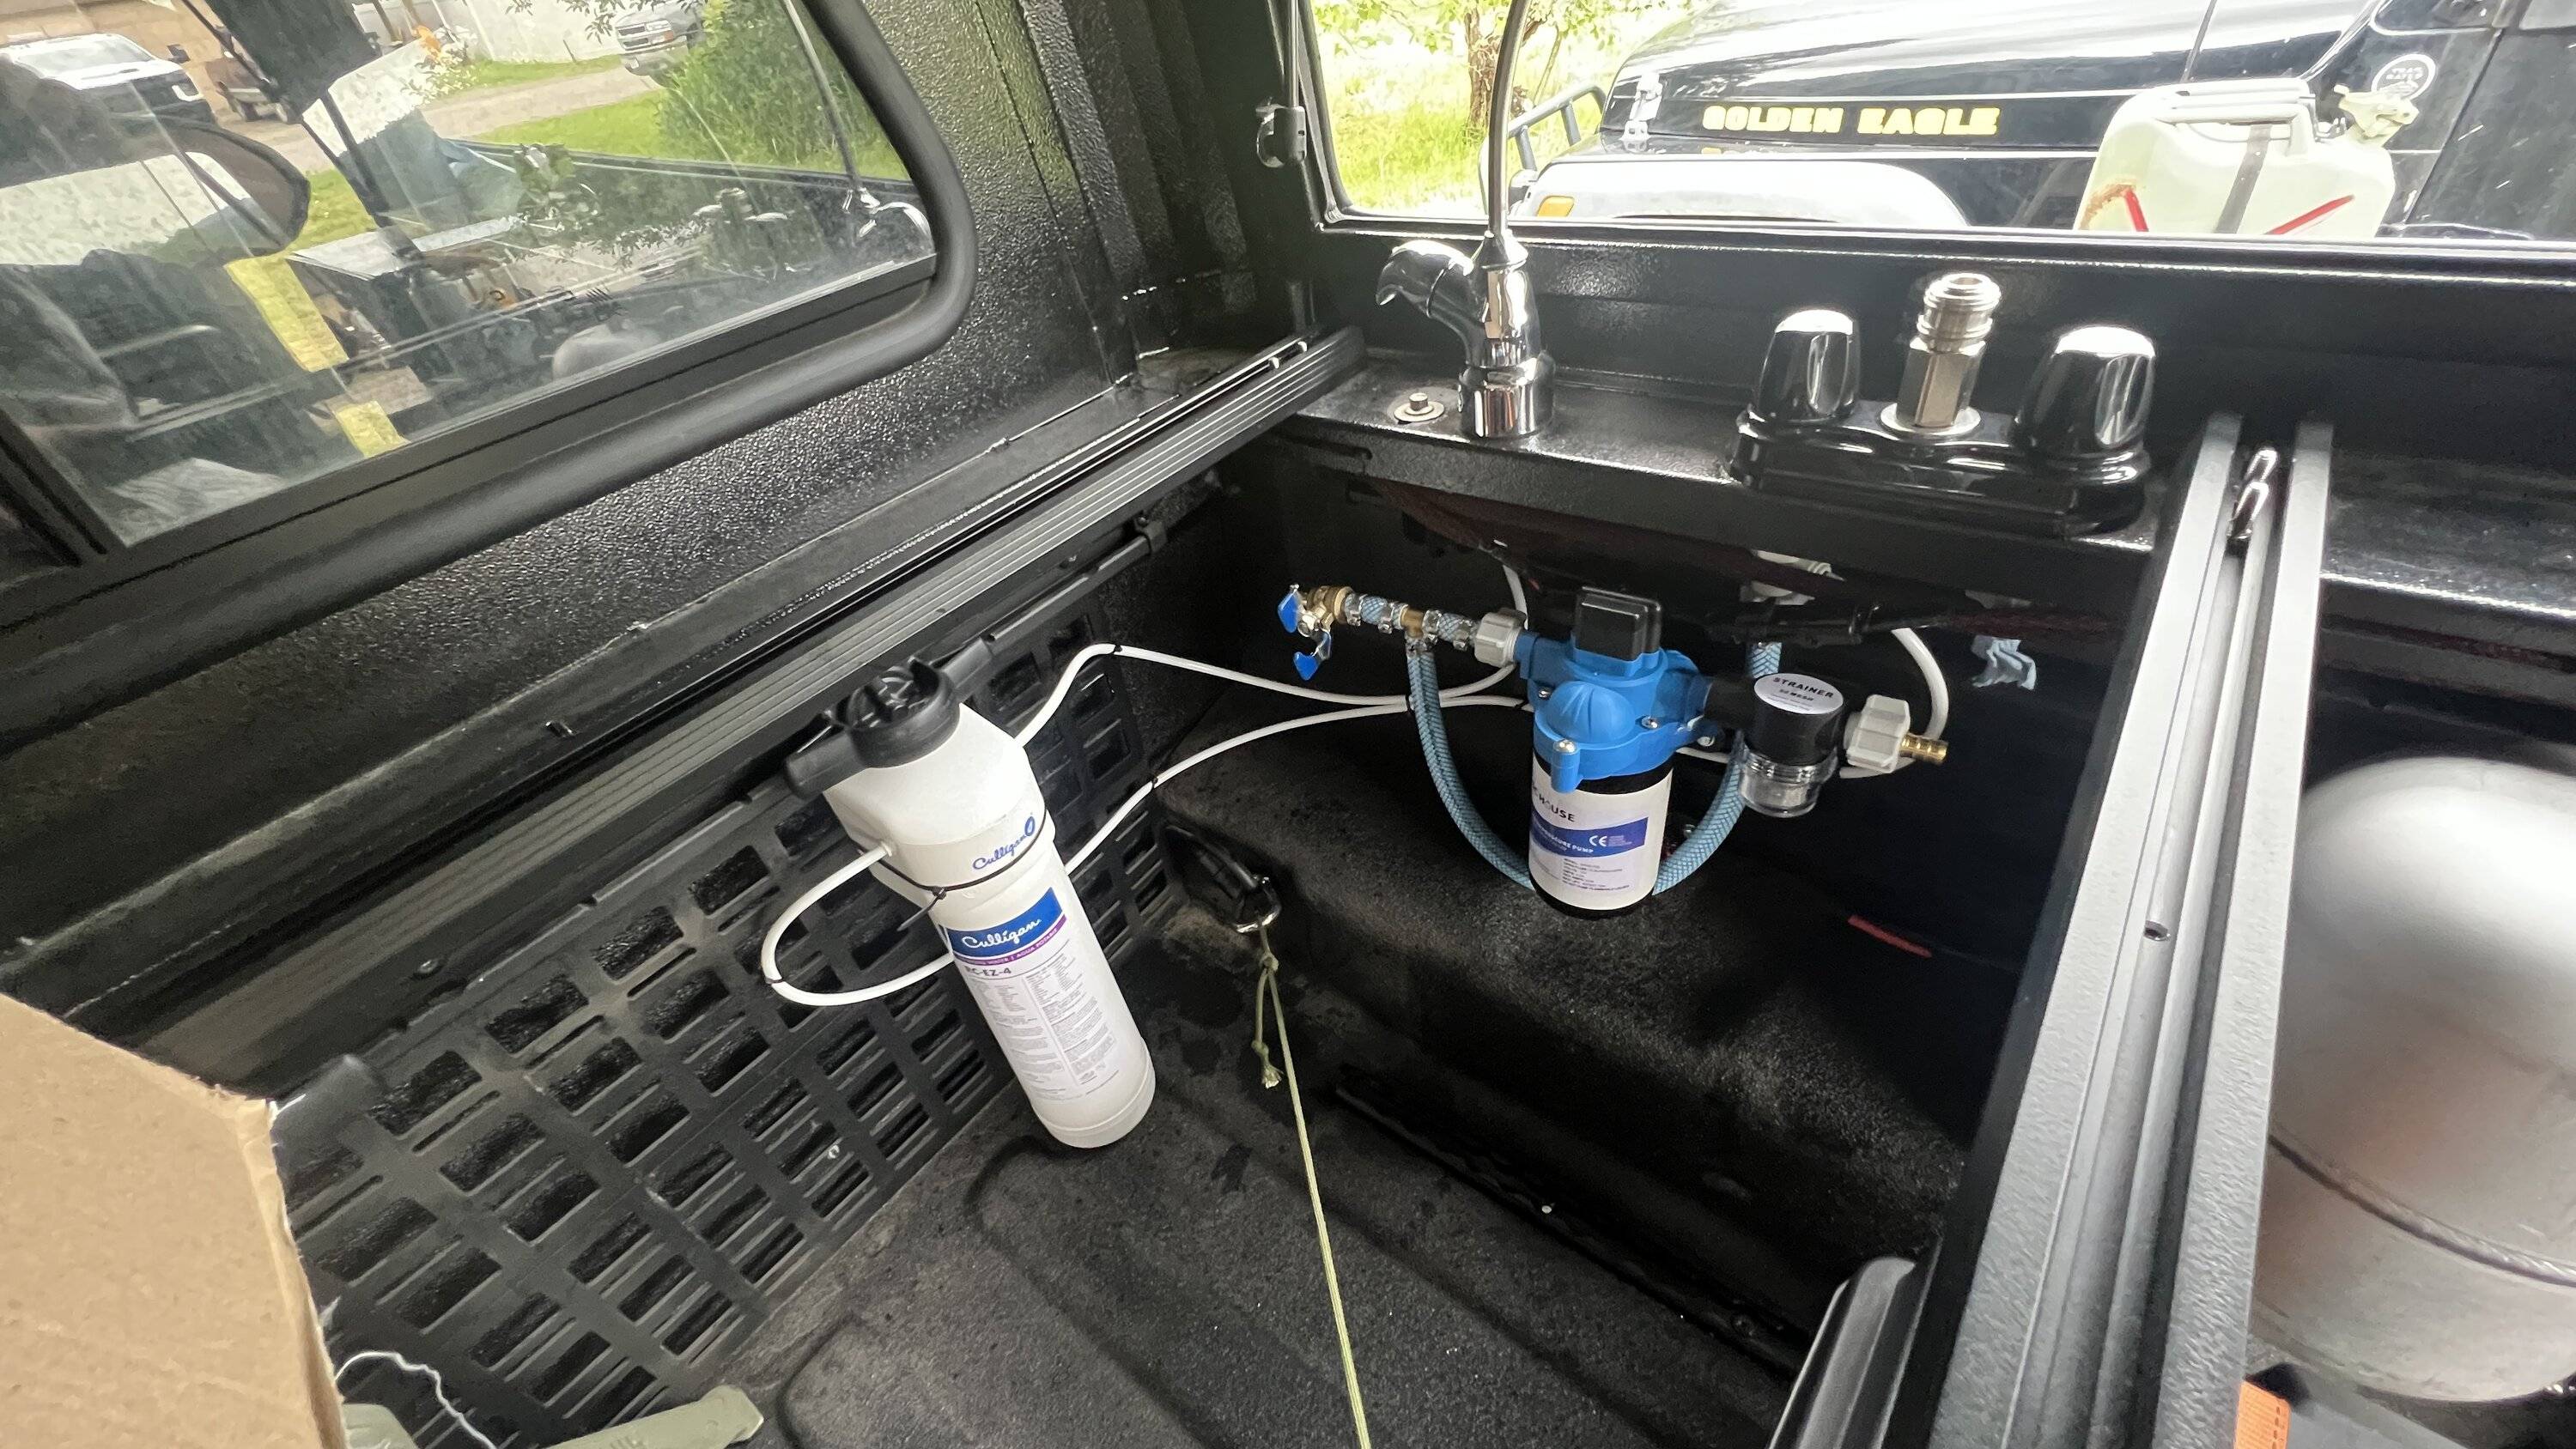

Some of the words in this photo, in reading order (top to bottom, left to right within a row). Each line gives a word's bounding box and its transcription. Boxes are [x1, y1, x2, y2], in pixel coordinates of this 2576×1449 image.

[1702, 105, 1844, 133] GOLDEN
[1856, 107, 2001, 135] EAGLE
[1773, 676, 1834, 698] STRAINER
[973, 834, 1028, 870] Culligan
[1572, 844, 1595, 853] PUMP
[962, 919, 1042, 948] Culligan
